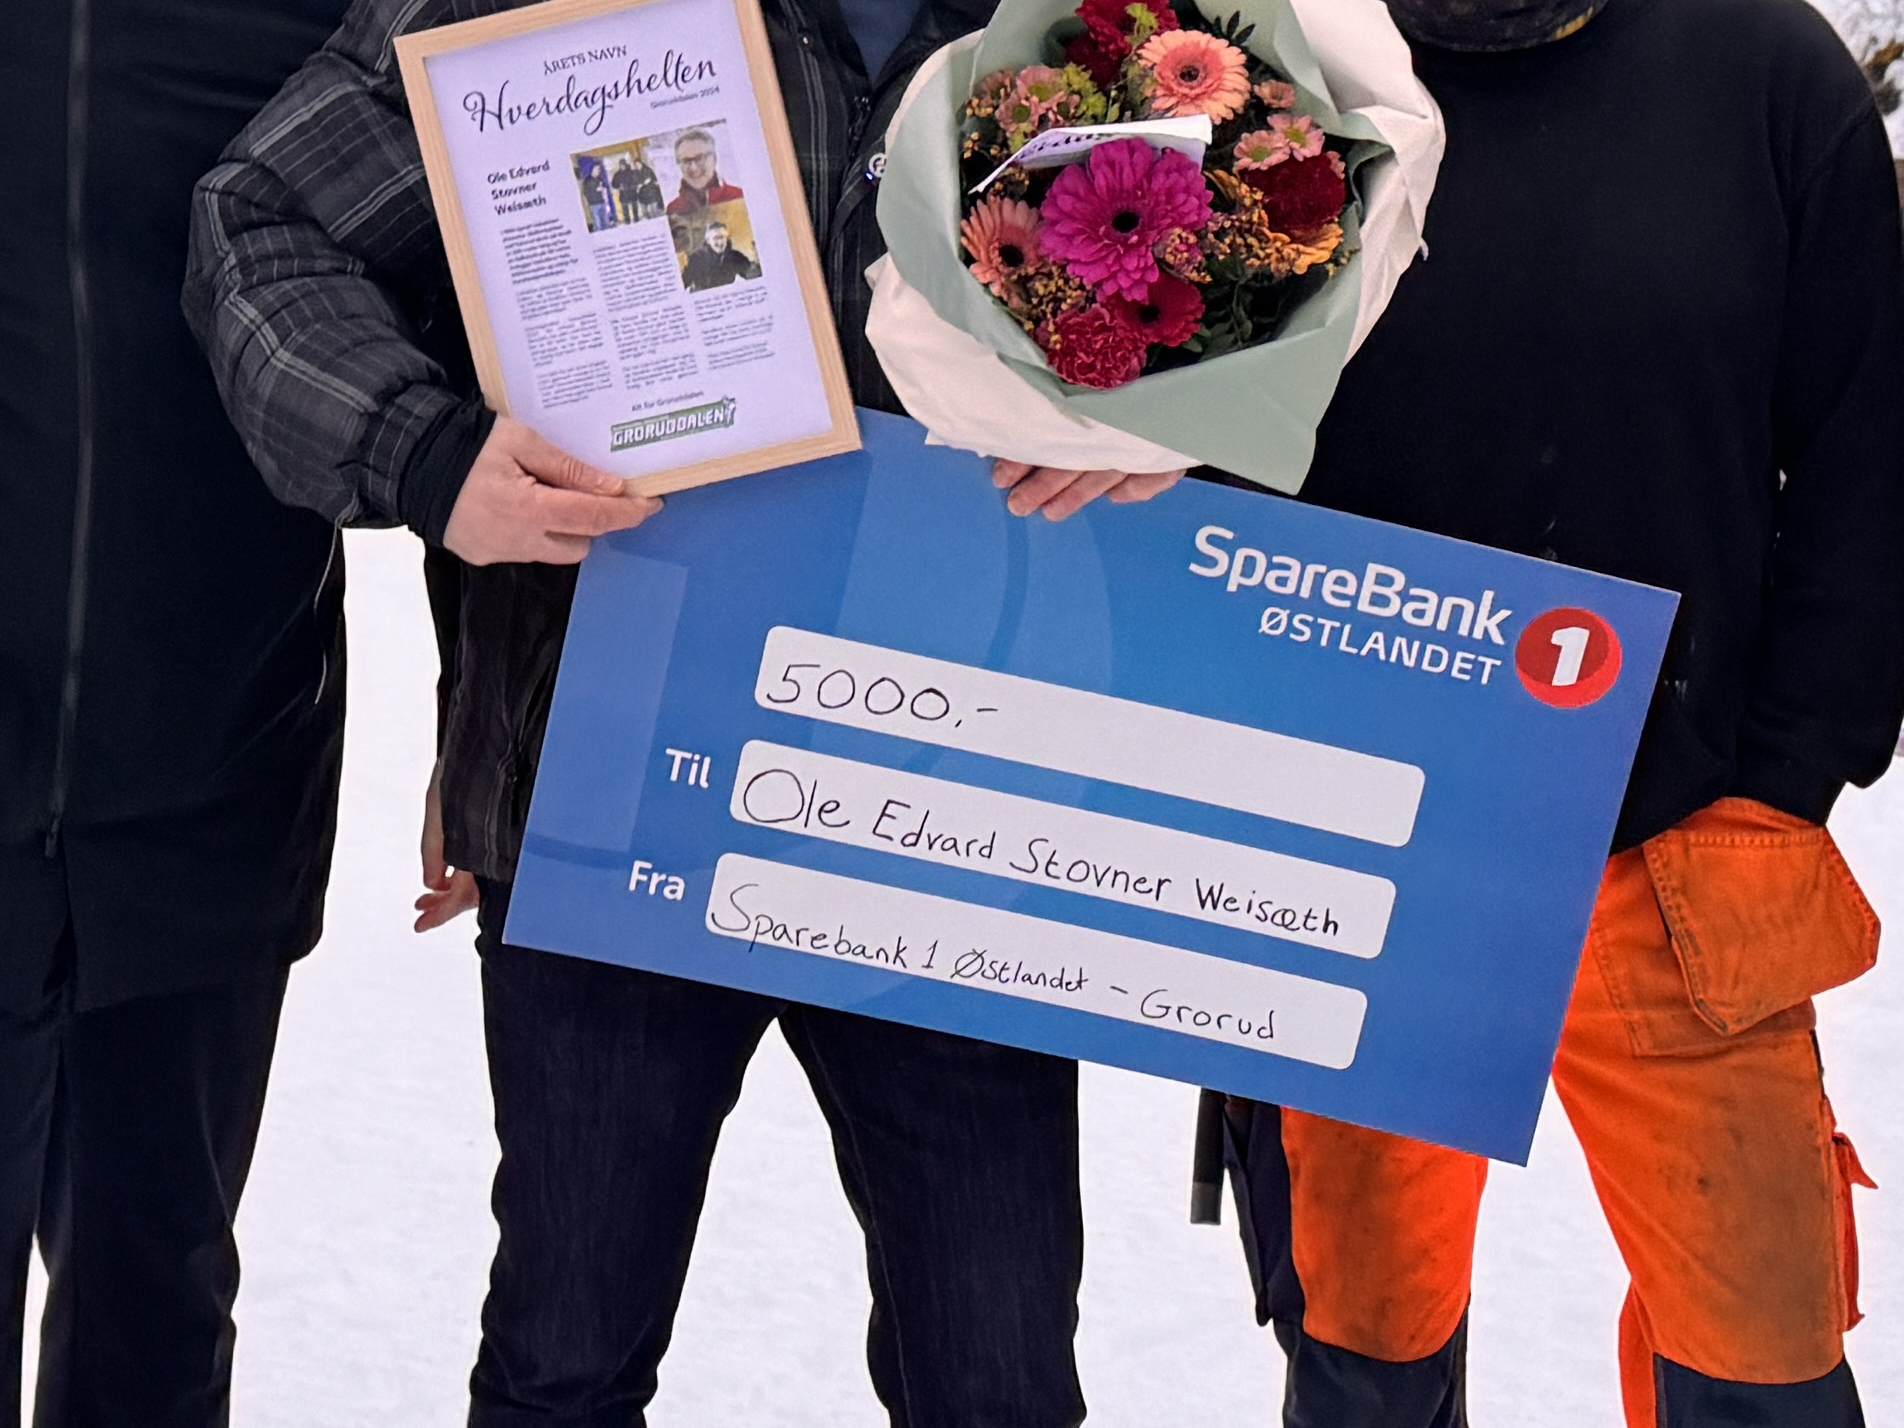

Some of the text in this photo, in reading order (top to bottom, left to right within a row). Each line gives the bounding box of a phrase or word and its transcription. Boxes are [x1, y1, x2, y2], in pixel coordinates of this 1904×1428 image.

[588, 44, 628, 61] NAVN
[463, 48, 717, 136] Hverdagshelten
[612, 407, 724, 446] GRORUDDALEN
[1188, 524, 1512, 646] SpareBank
[1258, 605, 1591, 687] ØSTLANDET 1
[766, 664, 999, 728] 5000,-
[664, 747, 712, 789] Til
[627, 859, 687, 902] Fra
[742, 768, 1340, 937] Ole Edvard Stovner Weisæth
[710, 883, 908, 953] Sparebank
[950, 947, 1089, 992] Østlandet
[1140, 988, 1276, 1040] Grorud
